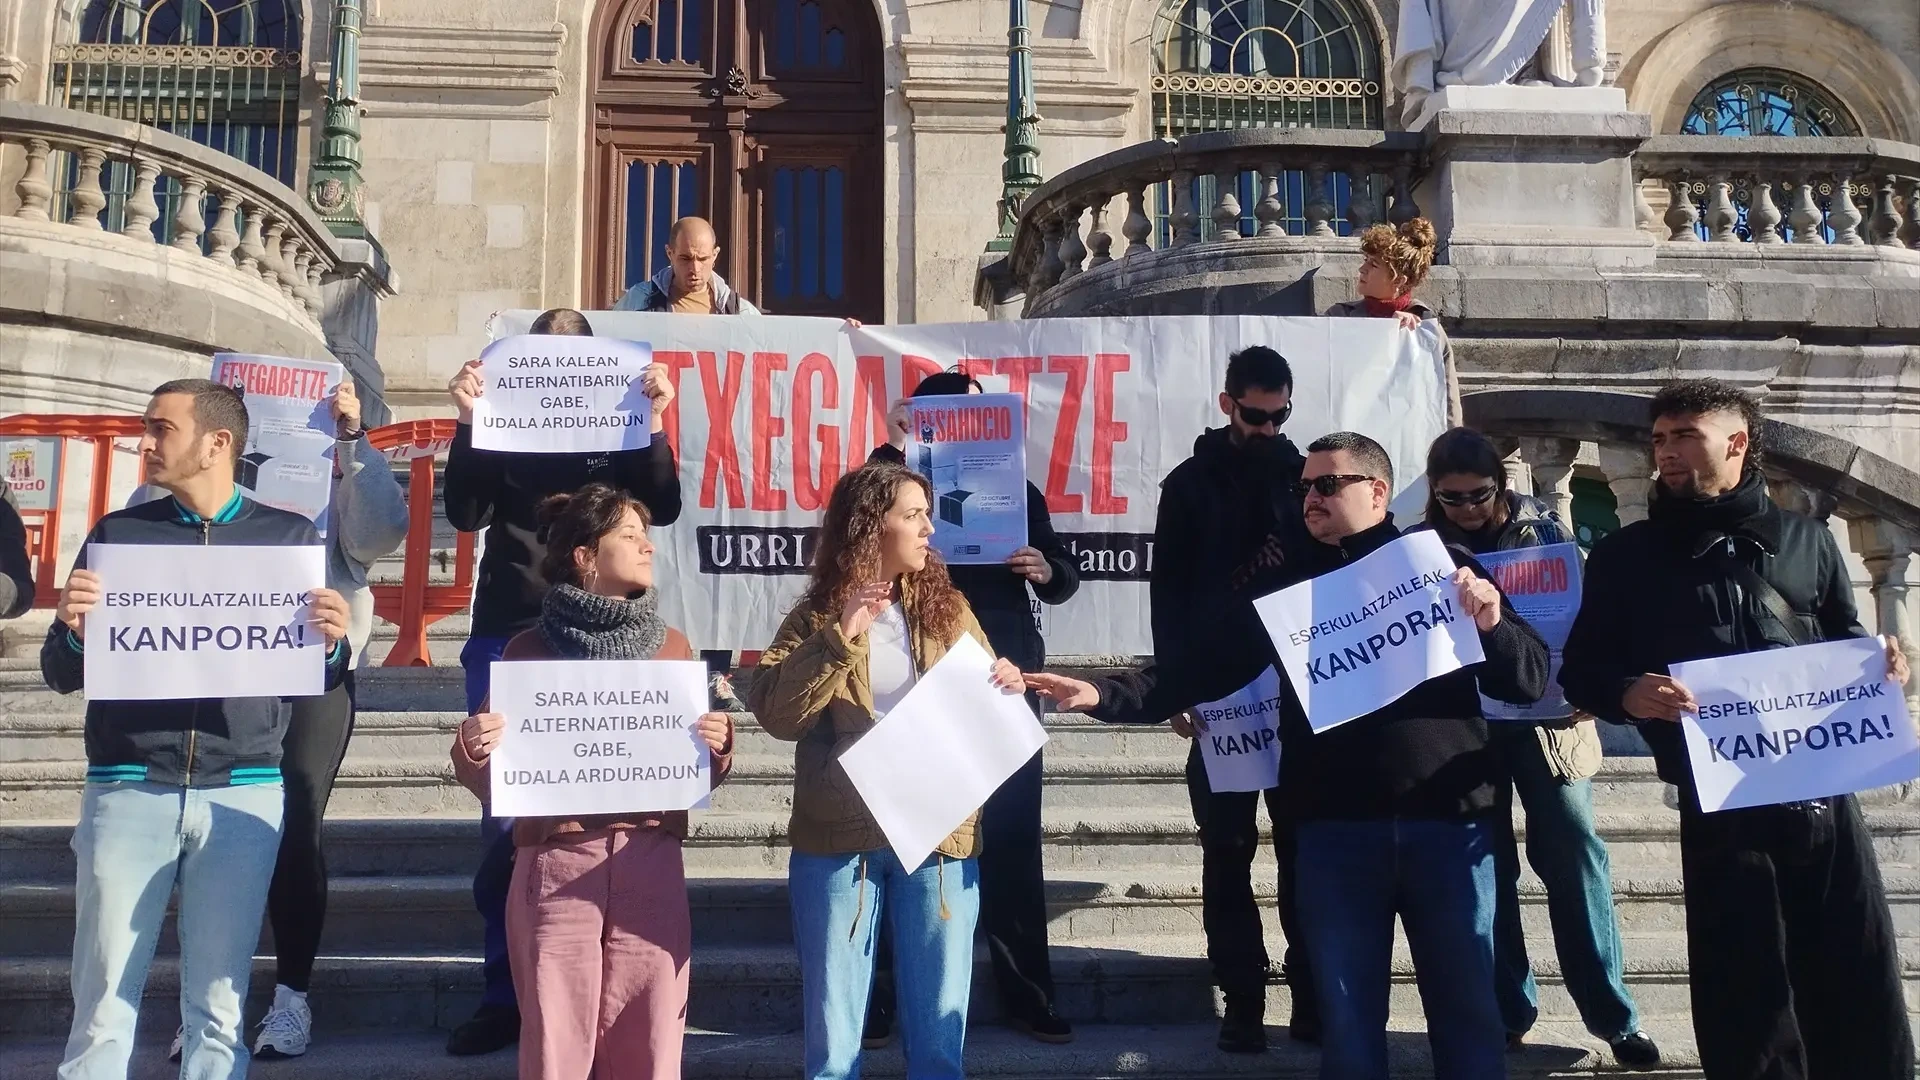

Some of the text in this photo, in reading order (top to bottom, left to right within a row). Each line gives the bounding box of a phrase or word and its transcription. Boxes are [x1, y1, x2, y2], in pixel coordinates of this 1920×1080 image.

[508, 356, 619, 368] SARA KALEAN
[497, 374, 631, 389] ALTERNATIBARIK
[540, 396, 589, 411] GABE,
[483, 413, 644, 429] UDALA ARDURADUN
[709, 534, 816, 567] URRI
[106, 592, 308, 607] ESPEKULATZAILEAK
[1289, 569, 1446, 647] ESPEKULATZAILEAK
[109, 625, 304, 652] KANPORA!
[1305, 598, 1455, 685] KANPORA!
[535, 690, 669, 707] SARA KALEAN
[1698, 682, 1885, 720] ESPEKULATZAILEAK
[520, 714, 684, 733] ALTERNATIBARIK
[1212, 728, 1281, 756] KANP
[1708, 714, 1894, 763] KANPORA!
[574, 742, 632, 759] GABE,
[504, 764, 700, 785] UDALA ARDURADUN
